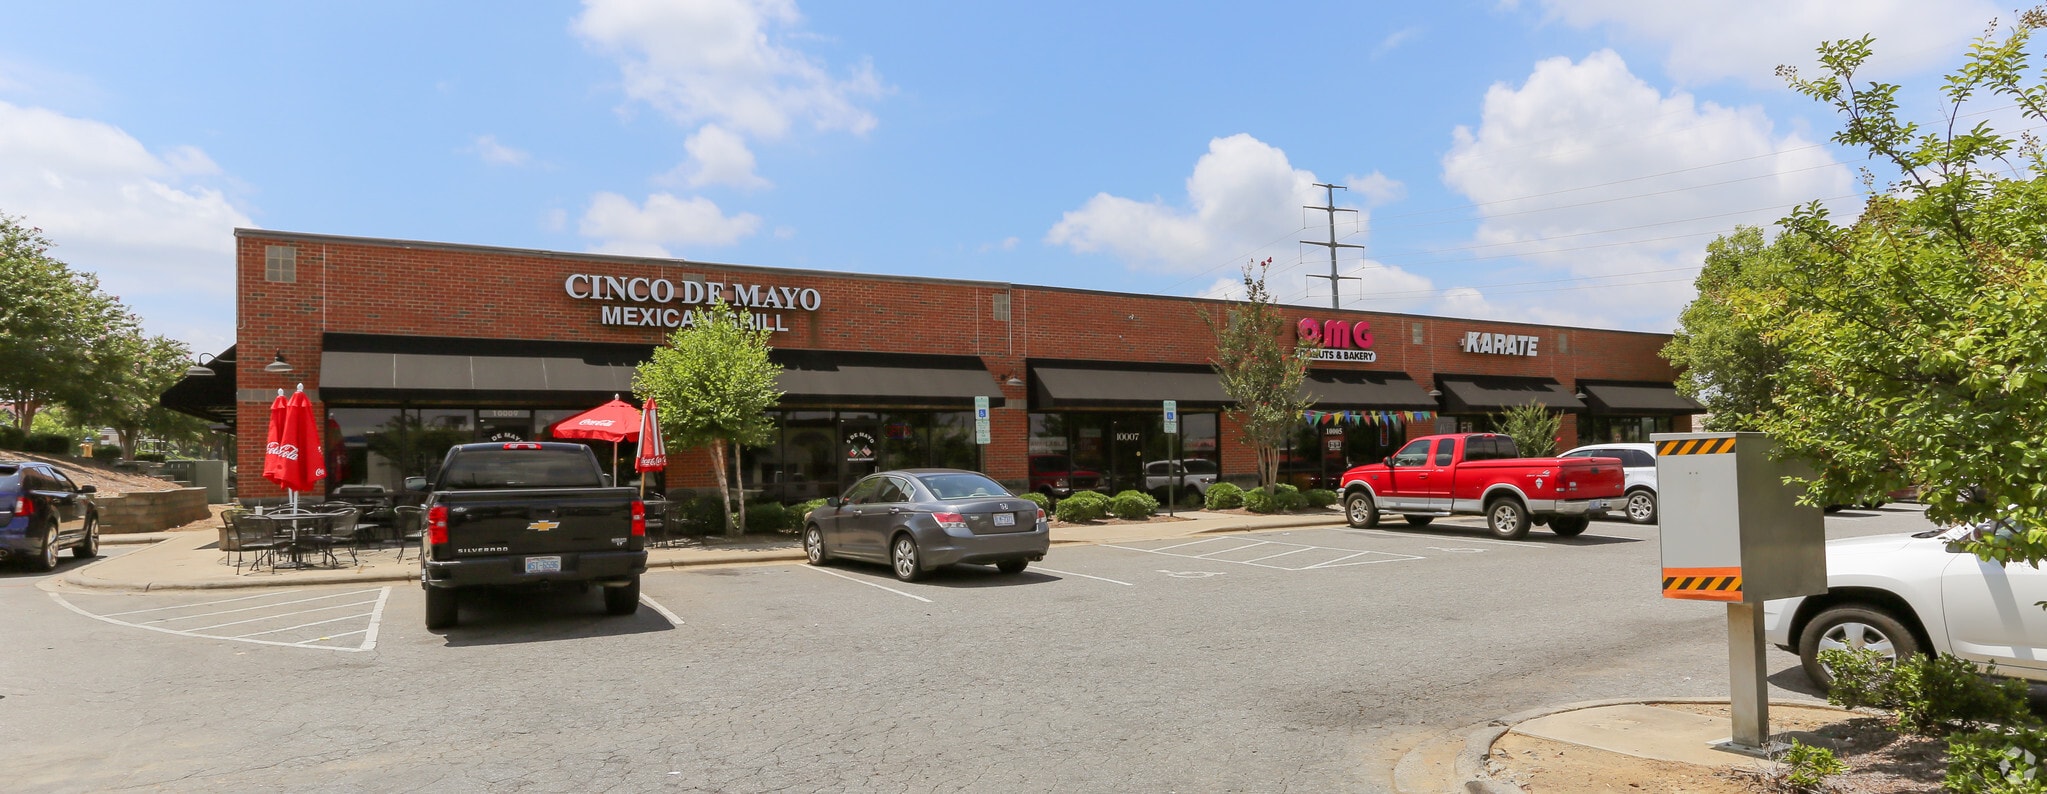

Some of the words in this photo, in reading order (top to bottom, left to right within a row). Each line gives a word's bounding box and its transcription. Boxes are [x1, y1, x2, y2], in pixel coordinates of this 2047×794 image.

[565, 273, 674, 303] CINCO
[682, 280, 725, 305] DE
[733, 283, 821, 311] MAYO
[1297, 317, 1375, 349] OMG
[1464, 331, 1539, 357] KARATE
[1336, 351, 1342, 360] &
[1344, 352, 1374, 361] BAKERY
[1116, 432, 1140, 441] 10007
[1326, 427, 1343, 435] 10005
[491, 433, 502, 442] DE
[859, 431, 875, 444] MAYO
